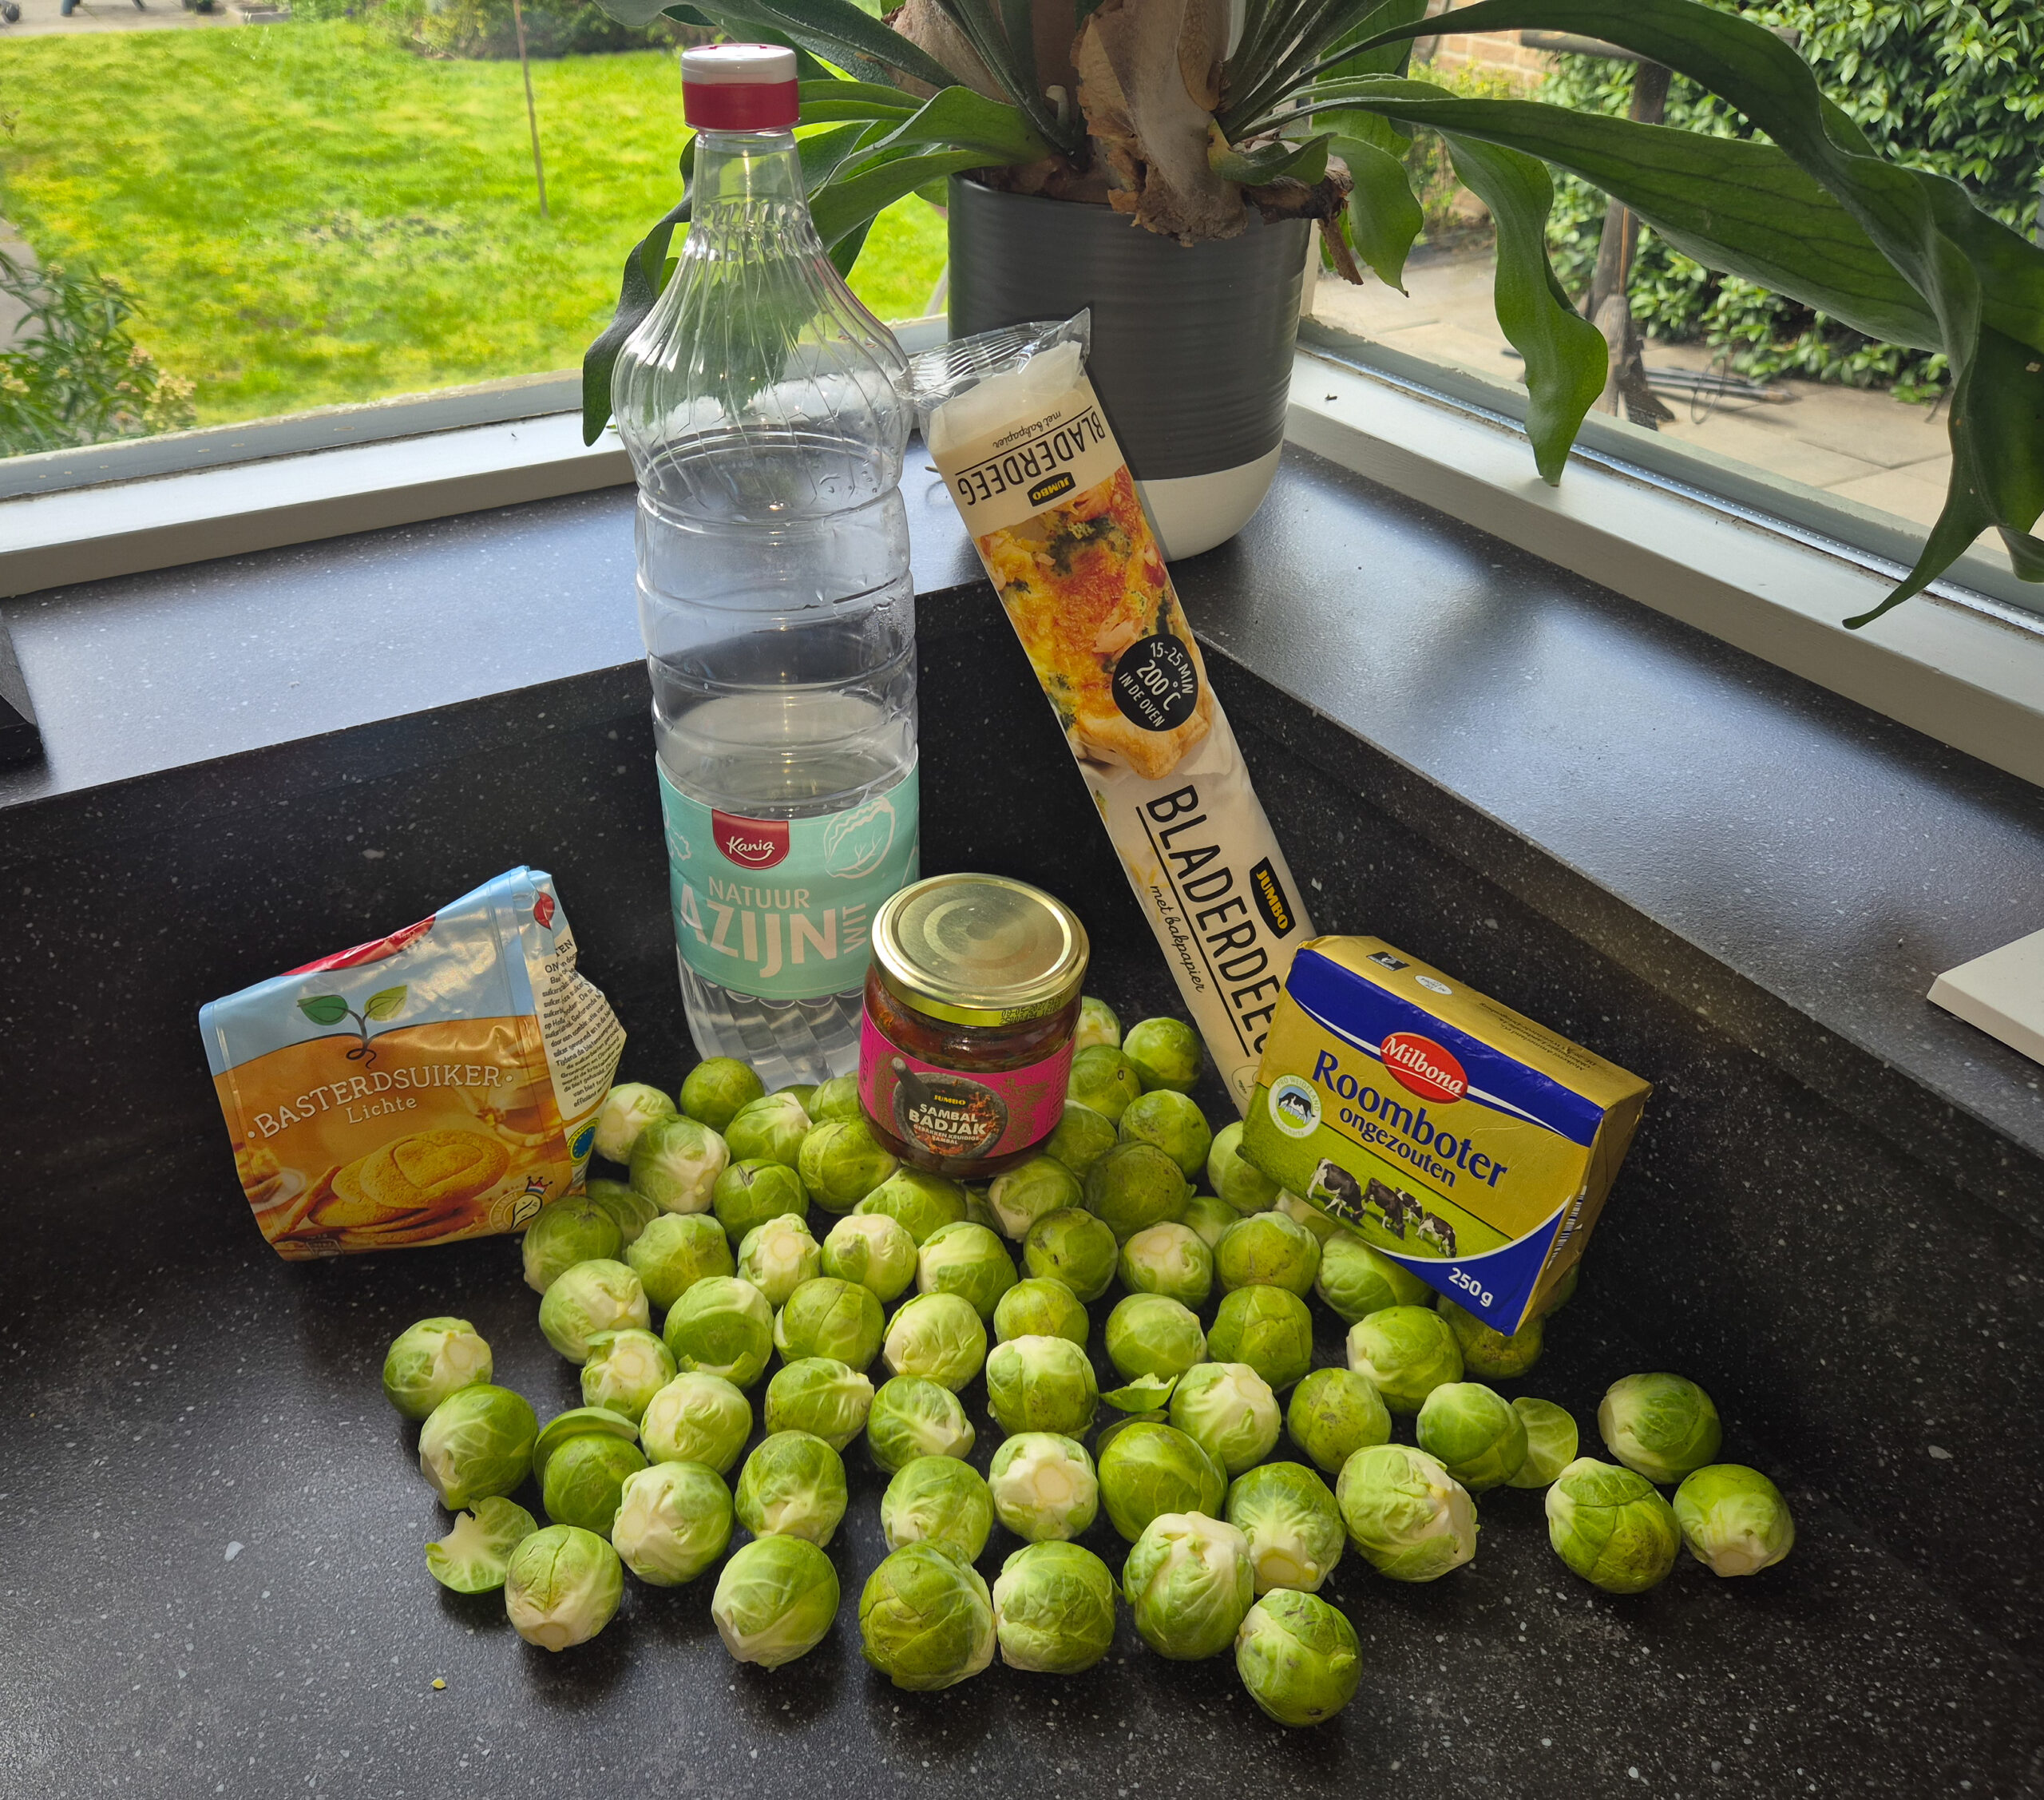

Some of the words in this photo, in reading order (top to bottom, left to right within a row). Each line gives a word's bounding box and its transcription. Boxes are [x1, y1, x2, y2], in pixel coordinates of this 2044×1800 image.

[992, 421, 1043, 448] bakpapier
[1043, 410, 1061, 427] met
[958, 410, 1106, 506] BLADERDEEG
[1032, 472, 1070, 502] JUMBO
[1151, 642, 1183, 666] 15-25
[1178, 663, 1194, 693] MIN
[1119, 672, 1134, 687] IN
[1128, 684, 1145, 701] DE
[1139, 699, 1165, 727] OVEN
[727, 836, 774, 861] Kania
[708, 876, 810, 909] NATUUR
[1257, 870, 1289, 930] JUMBO
[680, 883, 837, 978] AZIJN
[842, 902, 866, 954] WIT
[1151, 886, 1173, 914] met
[1165, 917, 1205, 993] bakpapier
[1382, 1037, 1464, 1095] Milbona
[255, 1065, 502, 1139] BASTERDSUIKER
[346, 1095, 418, 1124] Lichte
[920, 1104, 978, 1122] SAMBAL
[934, 1095, 966, 1105] JUMBO
[1277, 1076, 1289, 1088] PRO
[1289, 1076, 1321, 1112] WEIDELAND
[909, 1108, 988, 1135] BADJAK
[932, 1135, 958, 1144] SAMBAL
[1312, 1049, 1508, 1188] Roomboter
[1339, 1105, 1456, 1187] ongezouten
